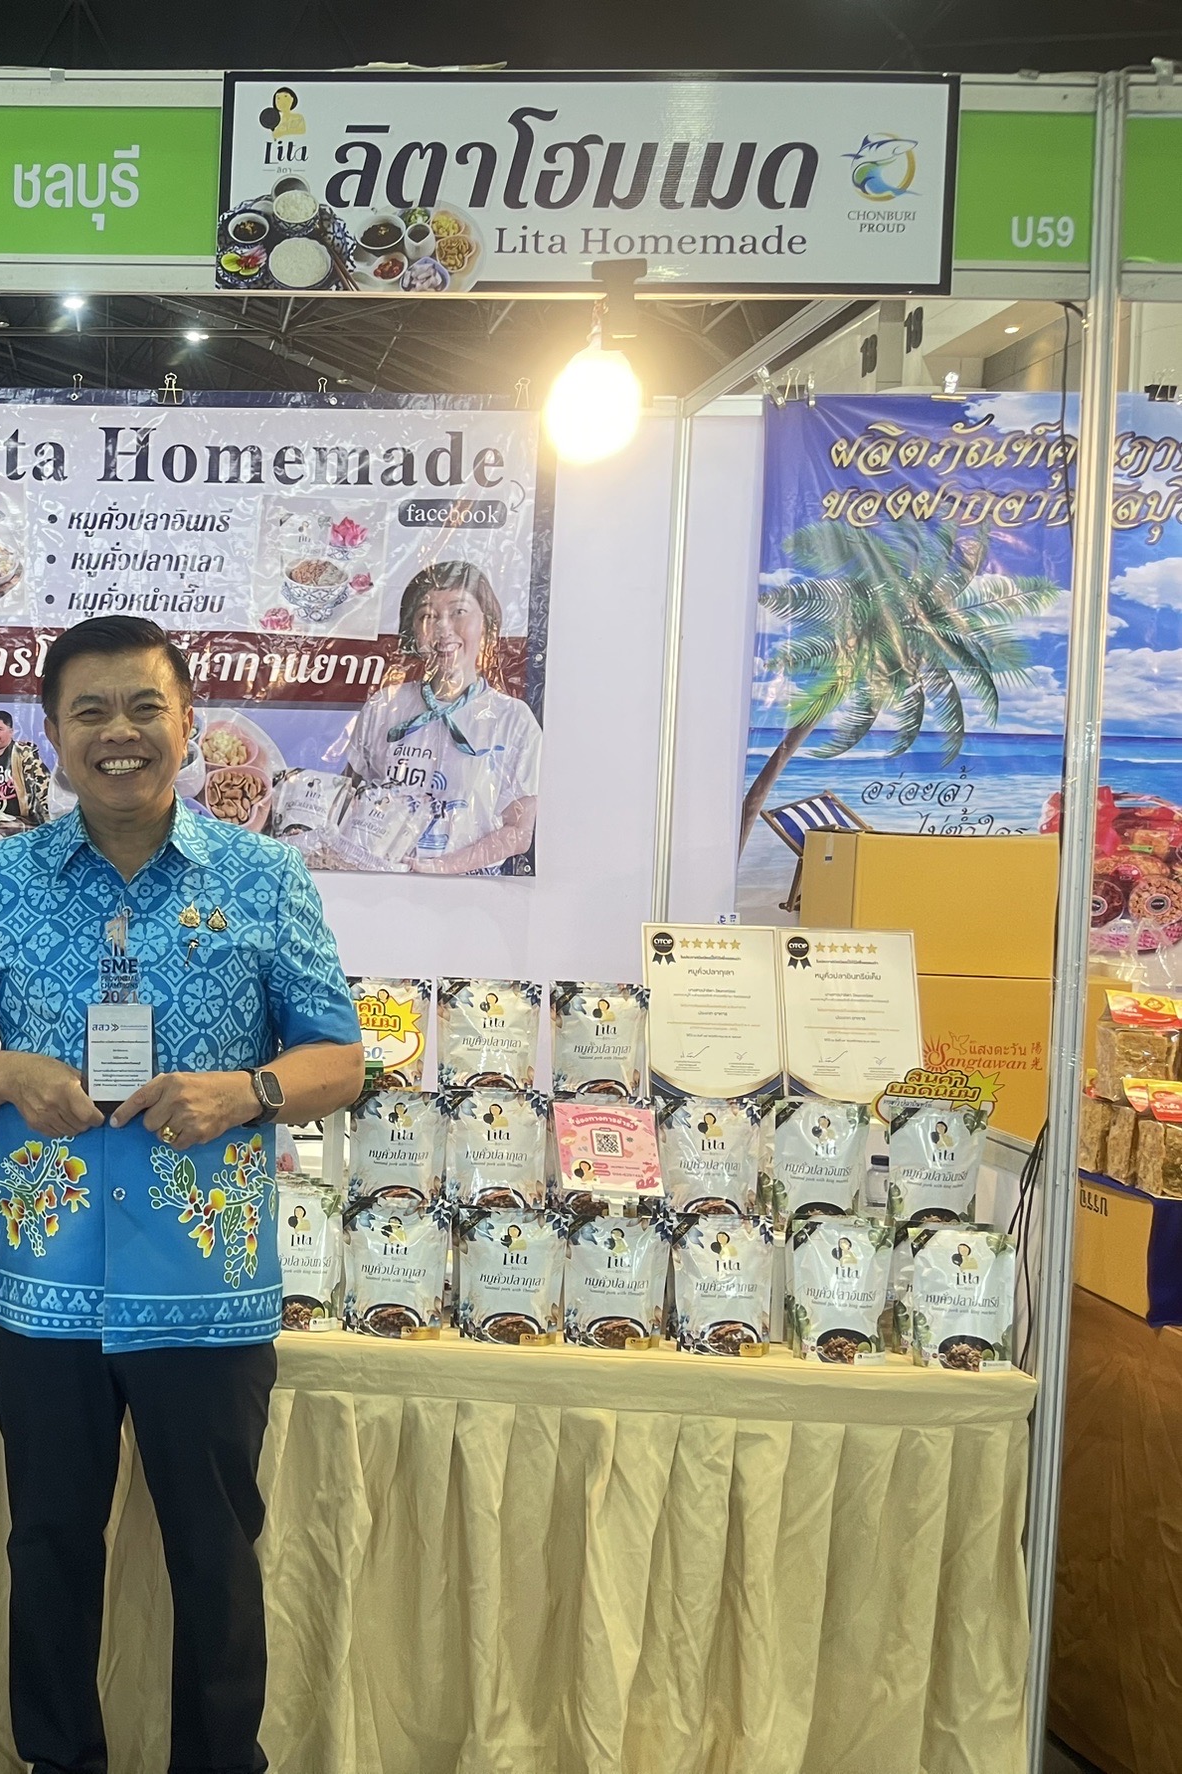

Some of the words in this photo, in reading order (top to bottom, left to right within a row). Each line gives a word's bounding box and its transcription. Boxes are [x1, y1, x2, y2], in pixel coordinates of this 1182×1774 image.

[264, 138, 308, 164] Lita
[325, 106, 819, 209] ลิตาโฮมเมด
[14, 145, 140, 231] ชลบุรี
[848, 211, 916, 221] CHONBURI
[859, 223, 905, 233] PROUD
[1012, 216, 1075, 248] U59
[494, 226, 567, 255] Lita
[580, 225, 807, 255] Homemade
[96, 426, 505, 489] Homemade
[67, 501, 234, 537] หมูคั่วปลาอินทรี
[406, 504, 500, 524] facebook
[70, 542, 224, 580] หมูคั่วปลากุเลา
[861, 765, 976, 807] อร่อยล้ำ
[101, 959, 138, 974] SME
[101, 990, 138, 1004] 2021
[595, 1023, 617, 1036] Lita
[969, 1042, 1027, 1057] แสงตะวัน
[908, 1070, 965, 1087] สินค้า
[888, 1084, 979, 1101] ยอดนิยม
[390, 1129, 414, 1142] Lita
[486, 1129, 511, 1142] Lita
[701, 1138, 725, 1151] Lita
[290, 1233, 313, 1247] Lita
[502, 1252, 527, 1266] Lita
[836, 1265, 860, 1280] Lita
[956, 1271, 980, 1287] Lita
